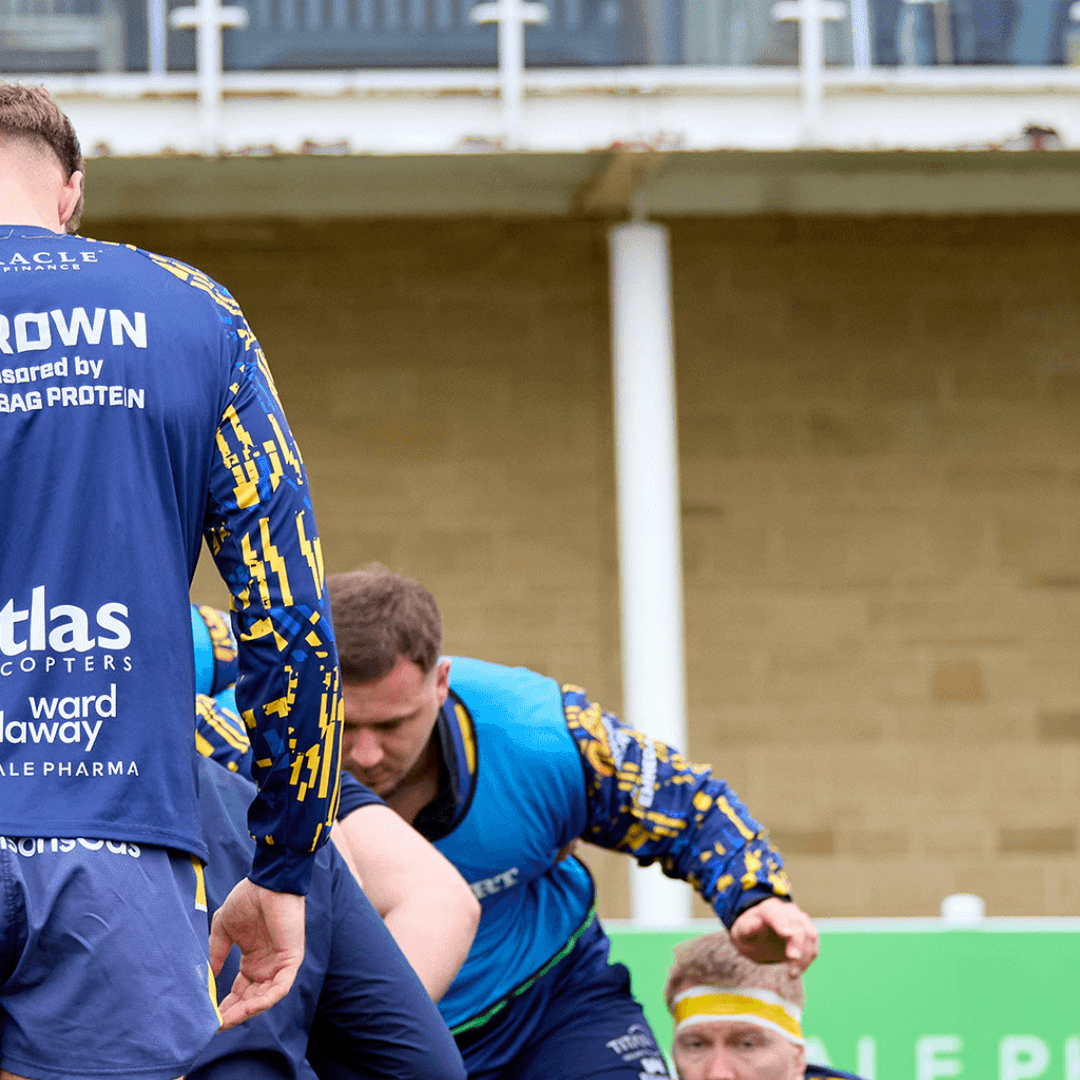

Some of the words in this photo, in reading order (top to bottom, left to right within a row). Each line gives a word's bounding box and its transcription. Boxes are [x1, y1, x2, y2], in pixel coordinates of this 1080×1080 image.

[3, 263, 81, 273] FINANCE
[75, 356, 104, 379] by
[46, 385, 145, 409] PROTEIN
[29, 683, 117, 719] ward
[43, 760, 139, 777] PHARMA
